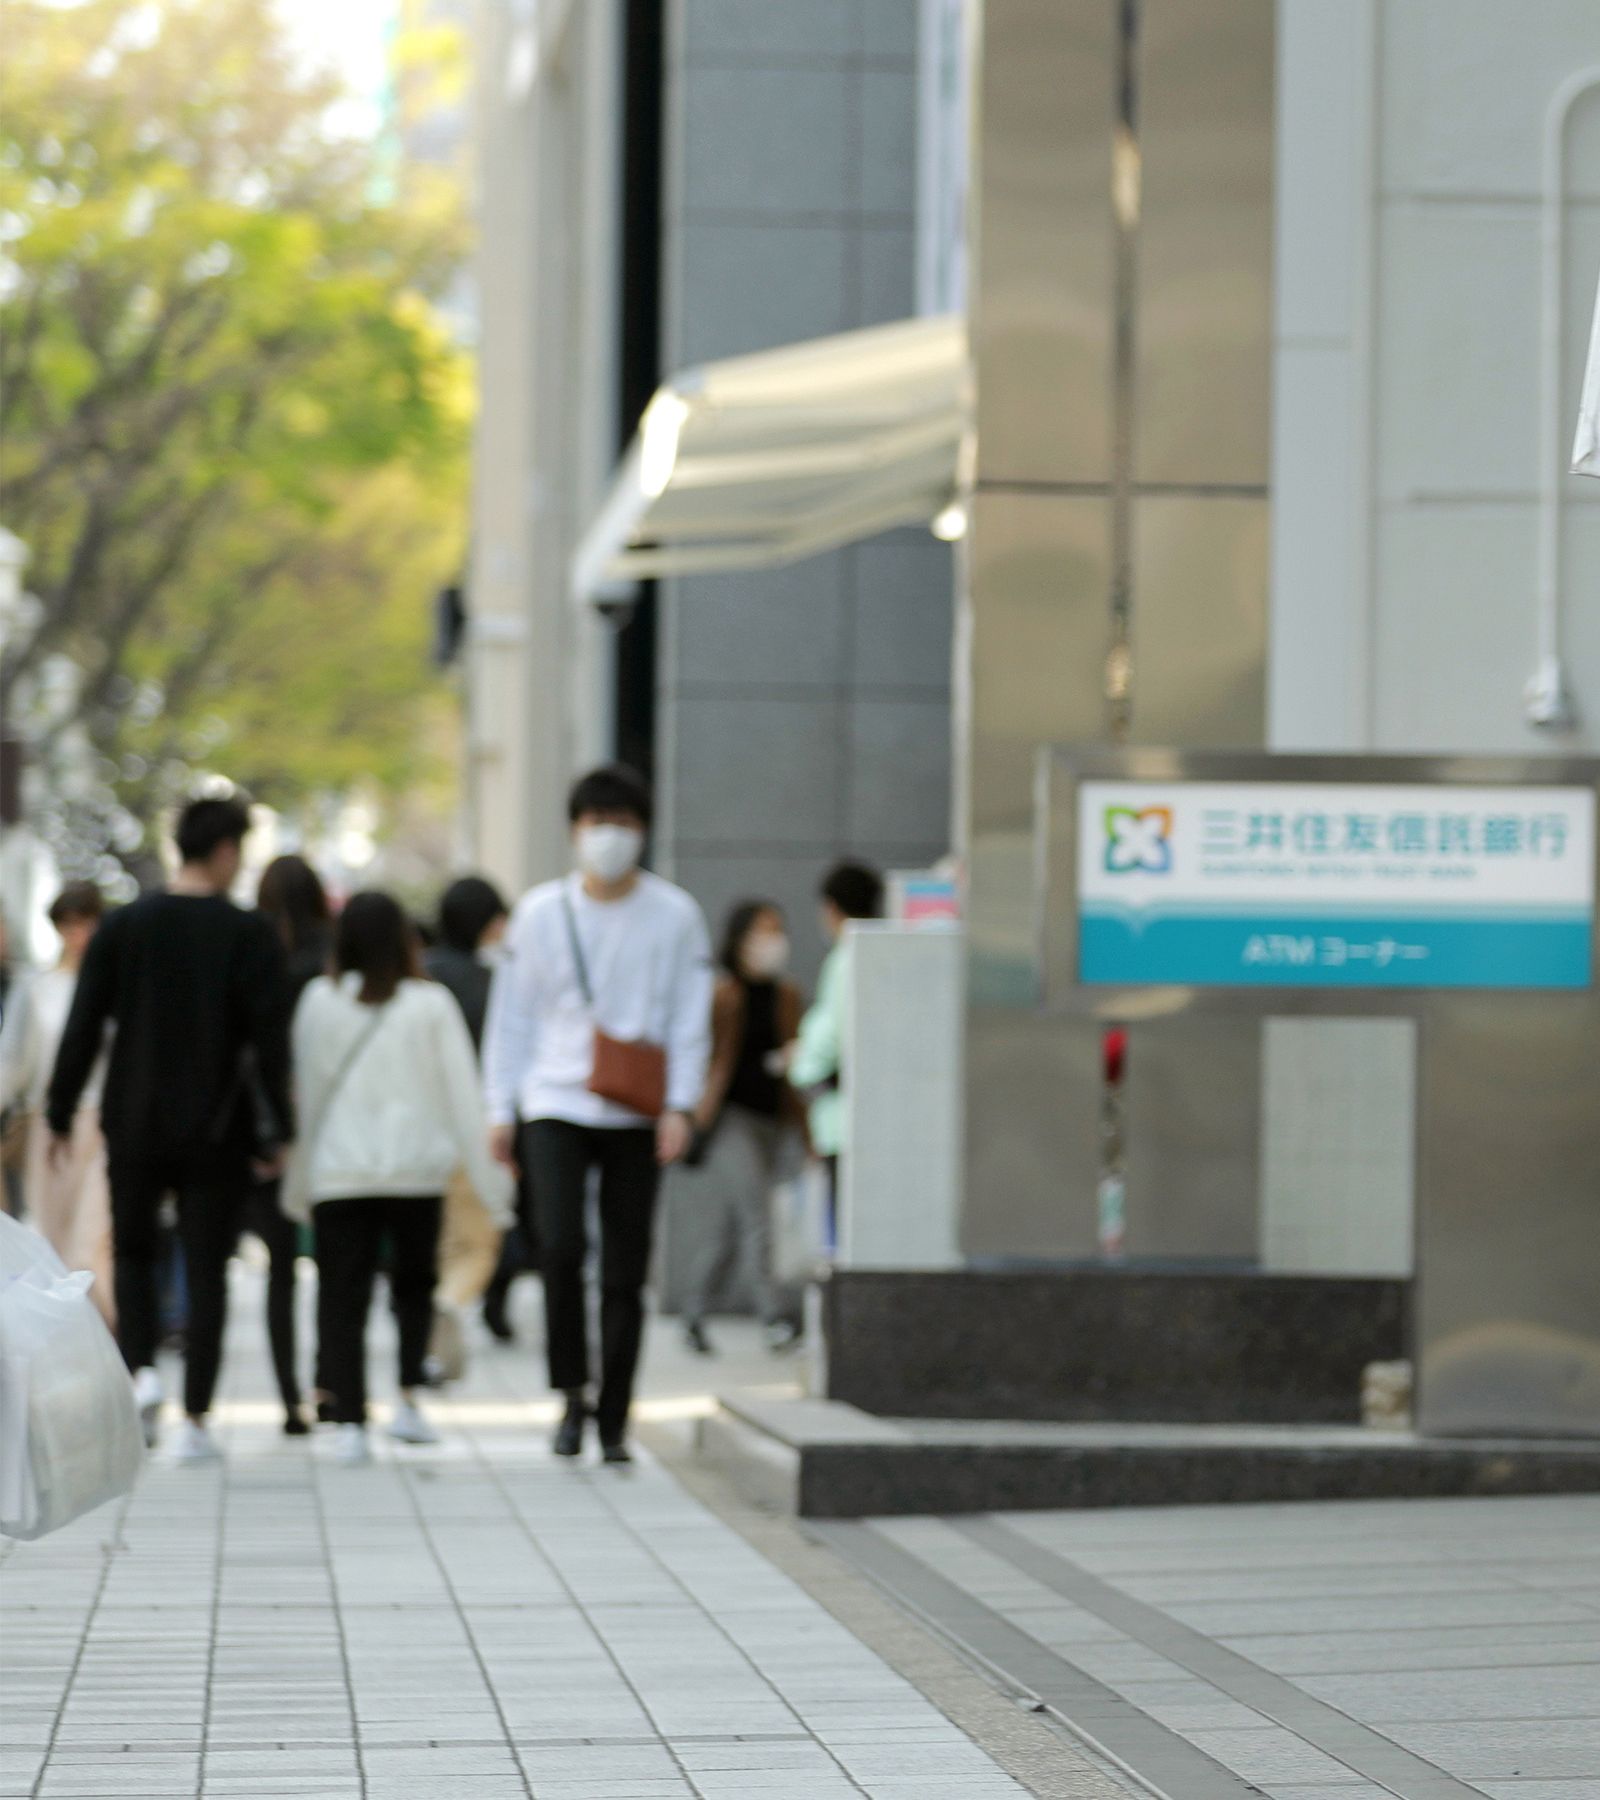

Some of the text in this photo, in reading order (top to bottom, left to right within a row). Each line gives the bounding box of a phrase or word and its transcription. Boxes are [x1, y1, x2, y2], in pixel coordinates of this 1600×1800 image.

[1201, 808, 1568, 860] 三井住友信託銀行
